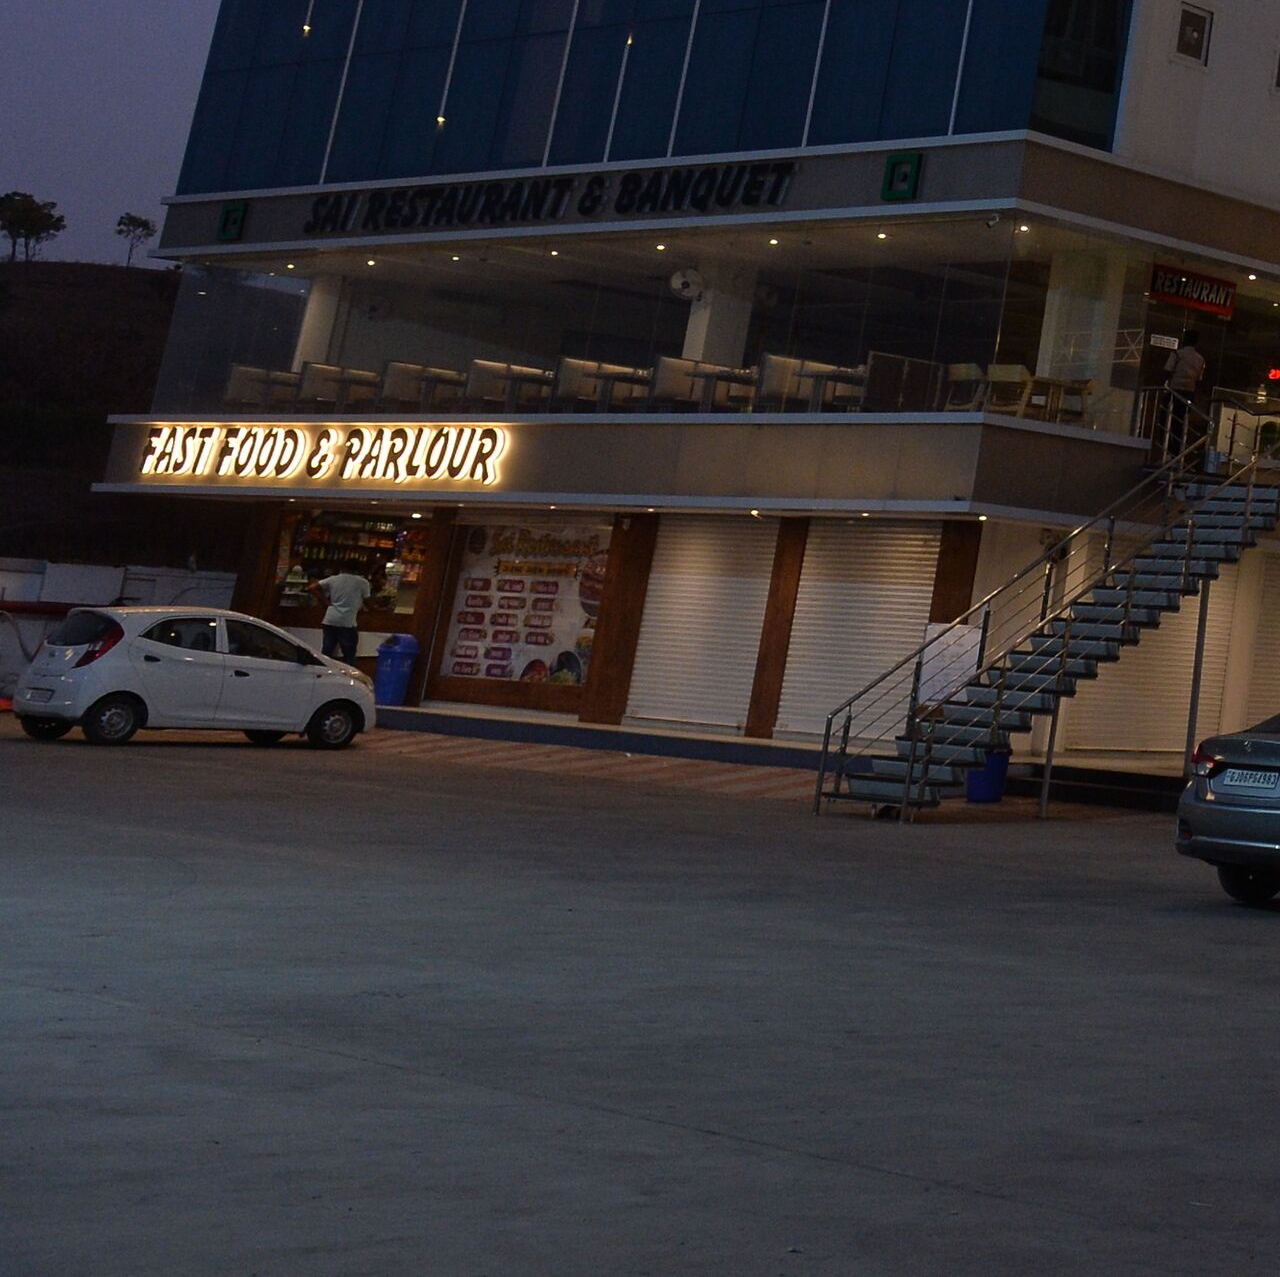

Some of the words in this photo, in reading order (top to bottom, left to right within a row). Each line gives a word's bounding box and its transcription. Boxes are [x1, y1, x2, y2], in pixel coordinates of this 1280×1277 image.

[304, 193, 358, 234] SAI
[361, 176, 576, 232] RESTAURANT
[577, 174, 607, 217] &
[613, 160, 795, 215] BANQUET
[1154, 270, 1236, 308] RESTAURANT
[141, 426, 218, 476] FAST
[214, 426, 307, 479] FOOD
[306, 427, 339, 480] &
[338, 426, 507, 486] PARLOUR
